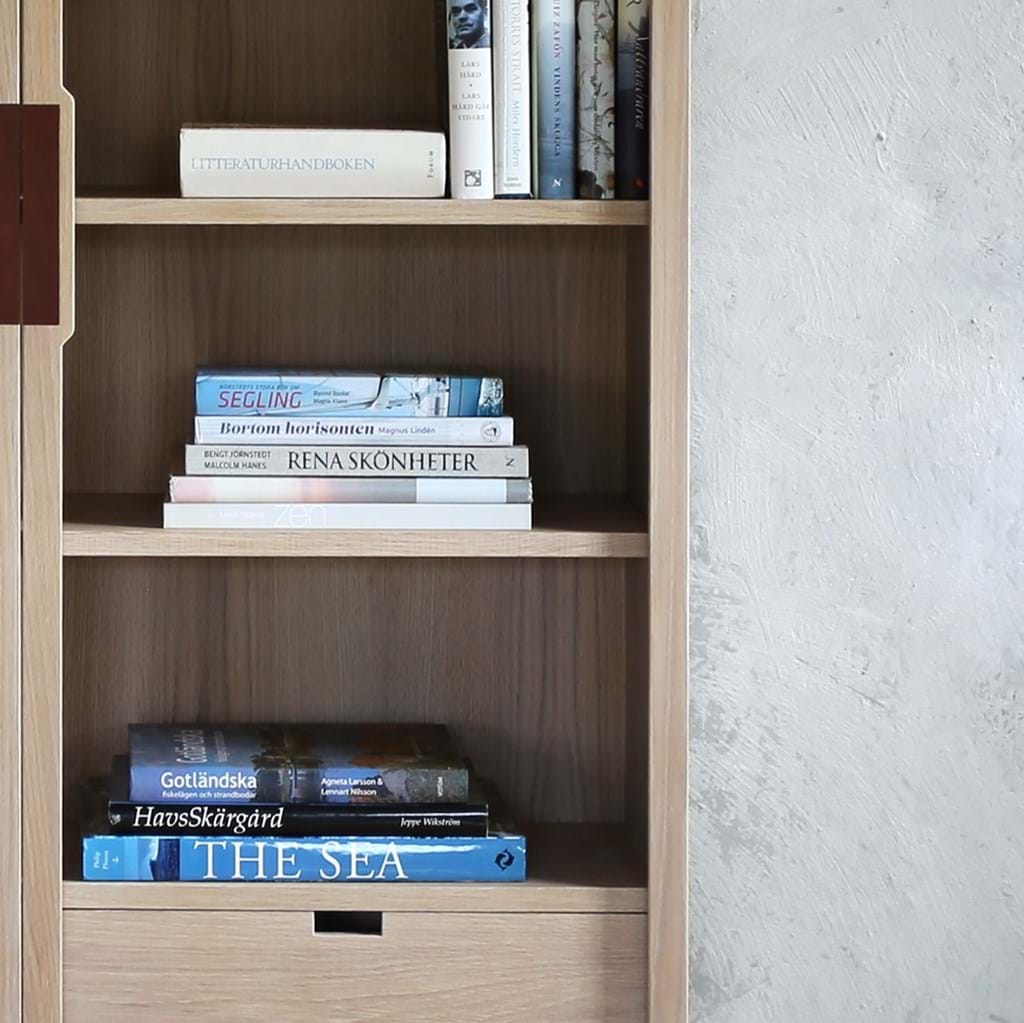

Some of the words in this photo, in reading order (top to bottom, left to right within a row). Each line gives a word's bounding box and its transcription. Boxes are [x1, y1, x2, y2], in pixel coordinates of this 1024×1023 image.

[511, 0, 522, 46] TORRES
[553, 21, 562, 58] ZAFÓN
[511, 50, 522, 94] STRAIT
[553, 66, 561, 114] VINDENS
[511, 100, 521, 126] Miles
[553, 117, 561, 157] SKUGGA
[191, 157, 375, 170] LITTERATURHANDBOKEN
[218, 391, 302, 409] SEGLING
[220, 422, 281, 435] Bortom
[285, 422, 375, 435] horisonten
[378, 426, 408, 435] Magnus
[410, 426, 436, 434] Lindén
[229, 449, 271, 458] JÖRNSTEDT
[288, 451, 344, 470] RENA
[348, 450, 478, 471] SKÖNHETER
[161, 772, 257, 789] Gotländska
[321, 778, 347, 787] Agneta
[162, 790, 198, 800] fiskelägen
[213, 790, 257, 799] strandbodar
[133, 805, 285, 834] HavsSkärgård
[400, 817, 421, 827] Jeppe
[423, 817, 461, 826] Wikström
[193, 840, 302, 880] THE
[319, 840, 408, 880] SEA
